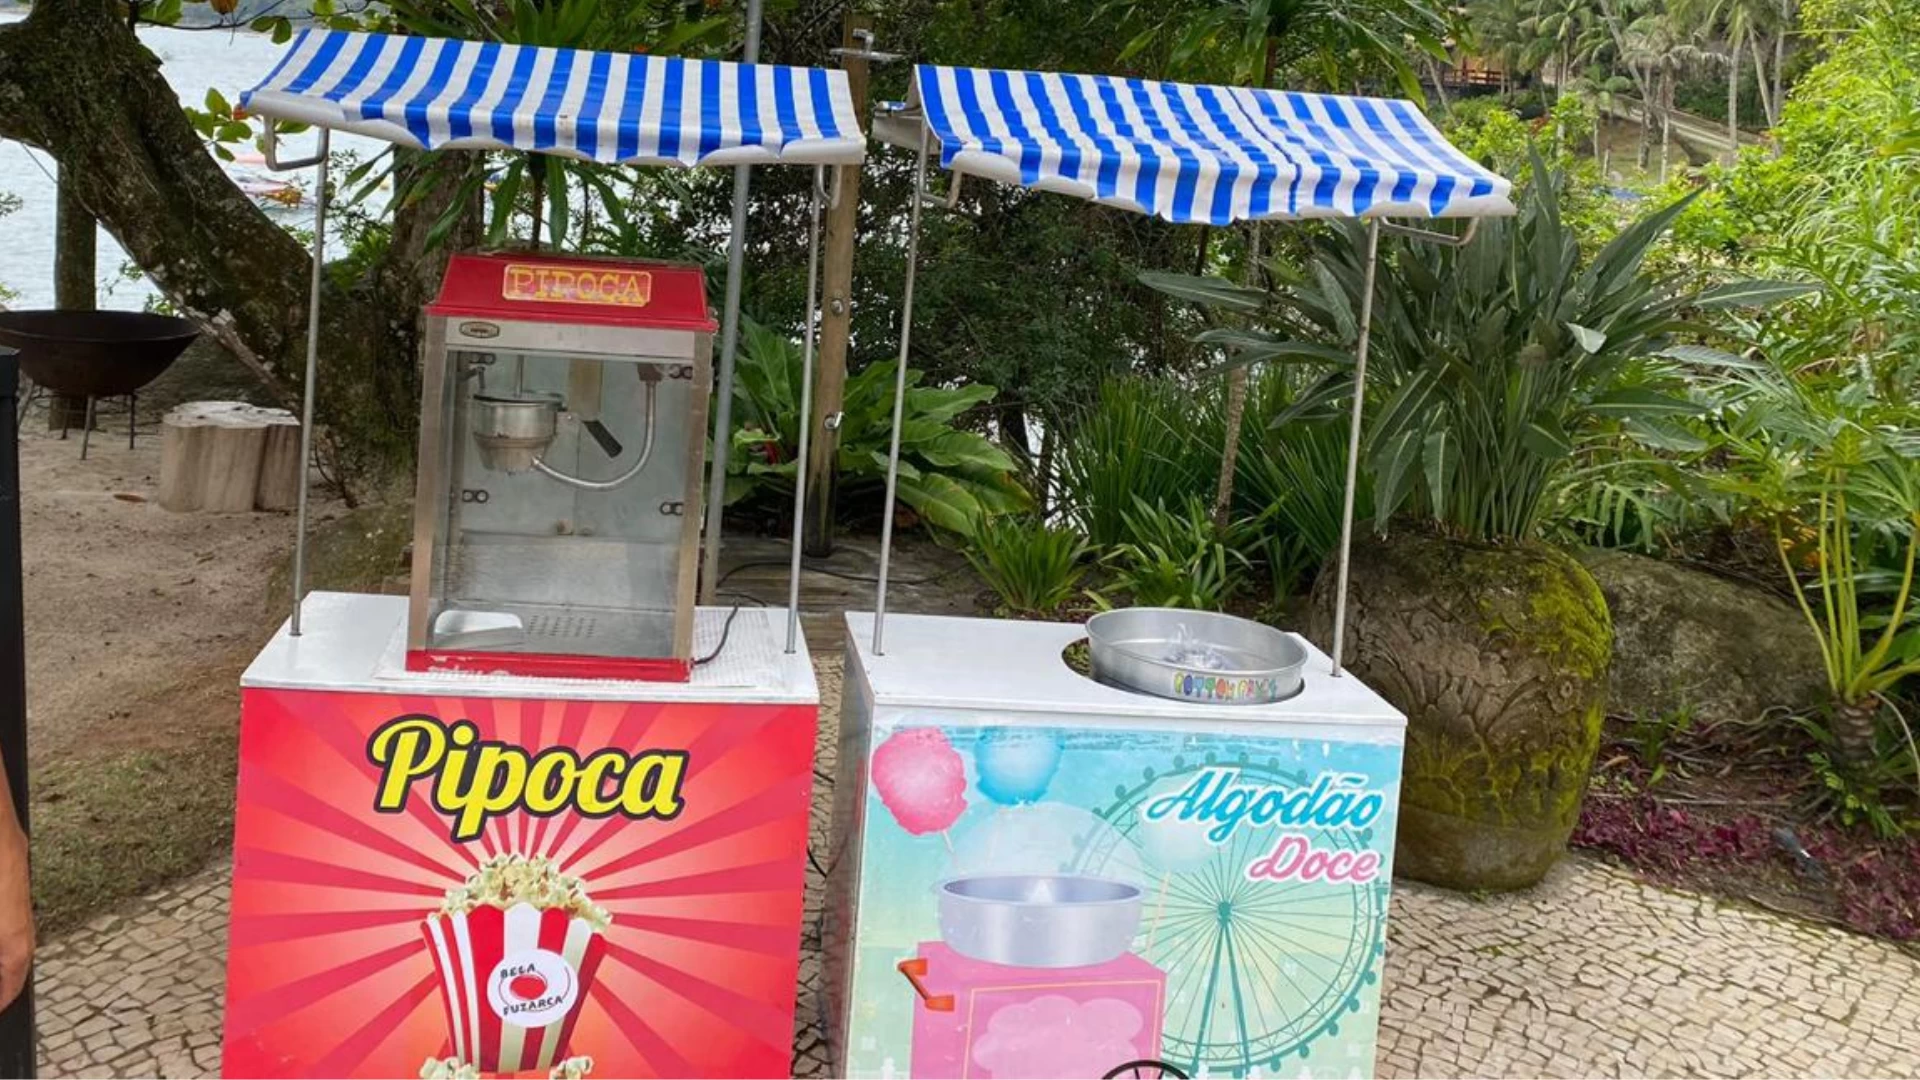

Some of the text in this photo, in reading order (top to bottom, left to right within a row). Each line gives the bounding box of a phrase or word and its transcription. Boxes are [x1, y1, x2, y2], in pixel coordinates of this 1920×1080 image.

[509, 268, 644, 304] PIPOCA
[368, 715, 688, 841] Pipoca
[1145, 769, 1384, 844] Algodão
[1247, 834, 1380, 883] Doce
[500, 963, 536, 979] BELA
[503, 995, 563, 1016] FUZARCA
